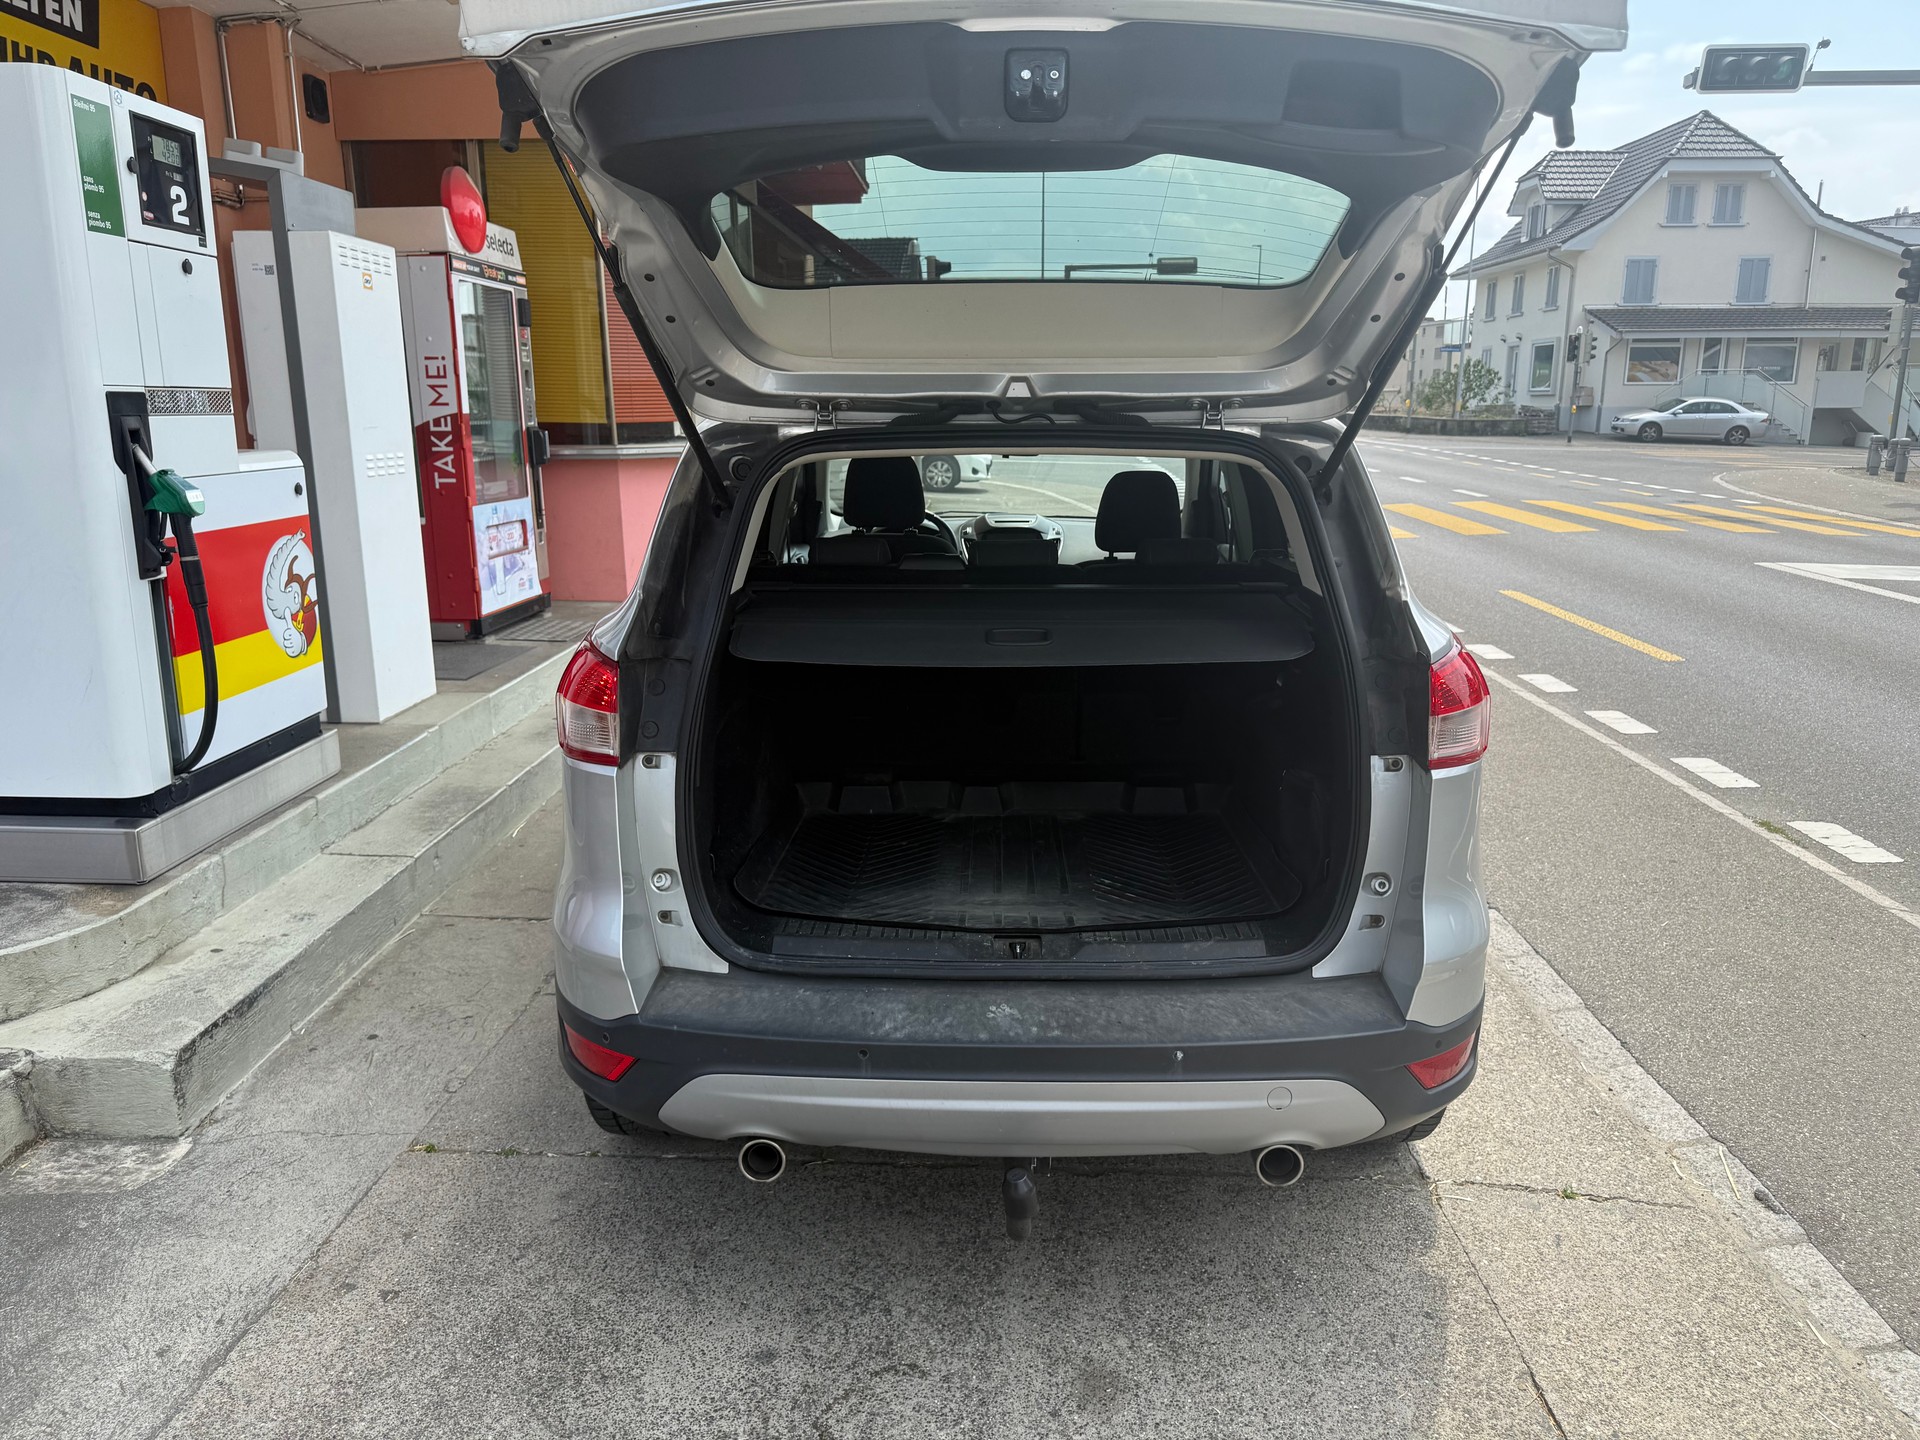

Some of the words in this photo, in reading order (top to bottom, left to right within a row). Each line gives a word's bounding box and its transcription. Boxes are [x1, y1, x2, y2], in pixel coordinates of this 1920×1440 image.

[90, 103, 96, 113] 95
[83, 175, 94, 184] sans
[84, 182, 98, 192] plomb
[170, 185, 190, 226] 2
[87, 210, 101, 221] senza
[486, 233, 514, 257] selecta
[424, 354, 450, 406] ME!
[428, 416, 456, 489] TAKE
